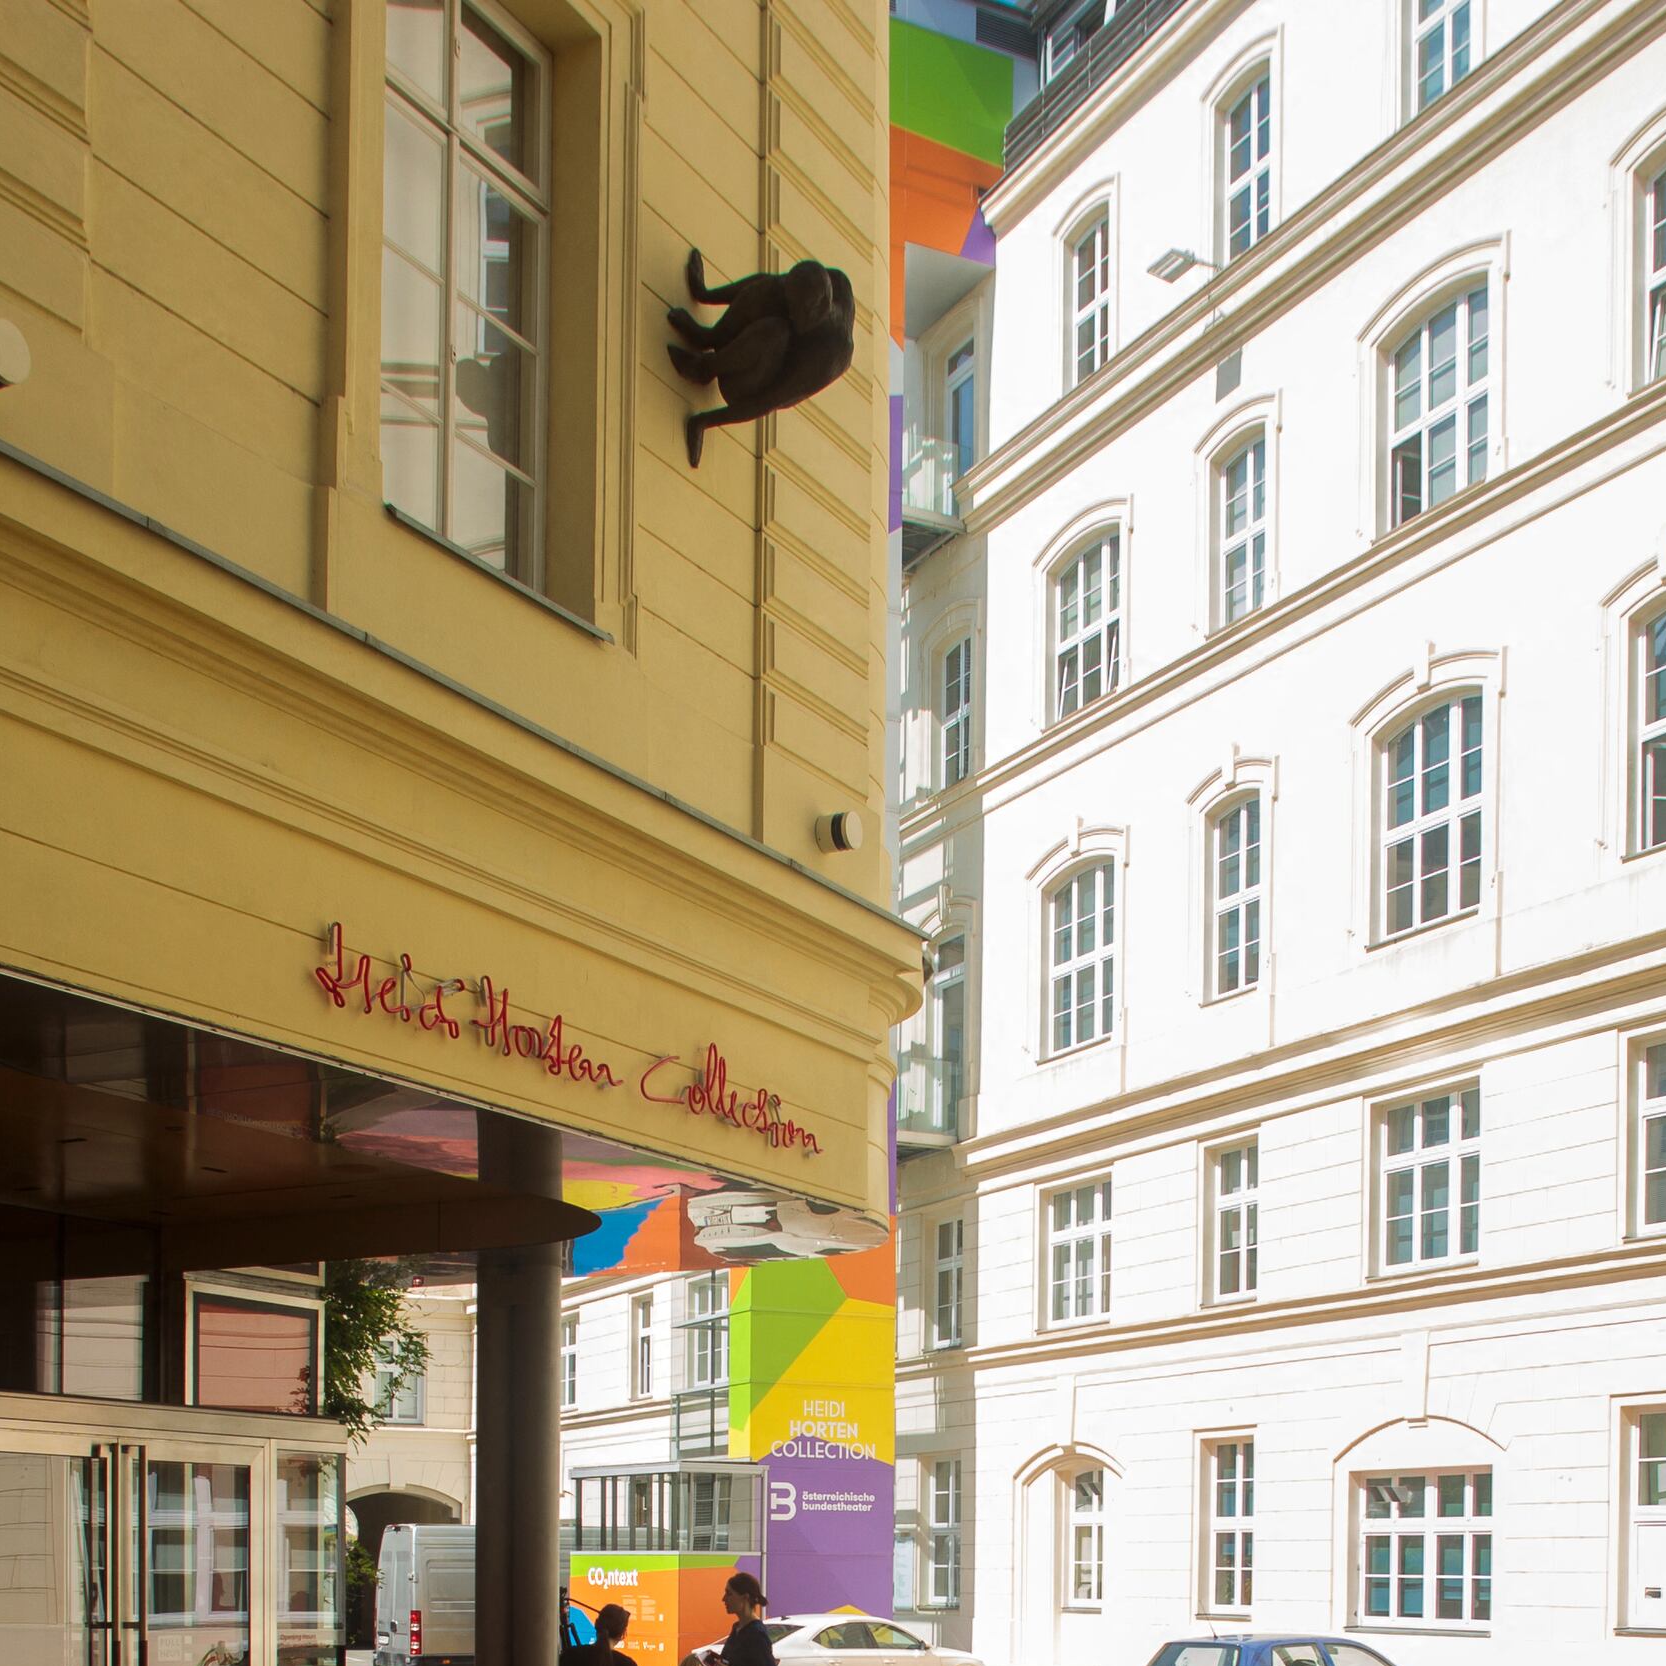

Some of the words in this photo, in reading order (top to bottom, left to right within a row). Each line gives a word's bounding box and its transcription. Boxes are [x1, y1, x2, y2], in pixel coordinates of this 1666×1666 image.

[803, 1400, 845, 1418] HEIDI
[789, 1420, 858, 1439] HORTEN
[771, 1440, 876, 1460] COLLECTION
[802, 1491, 875, 1502] österreichische
[802, 1502, 872, 1512] bundestheater
